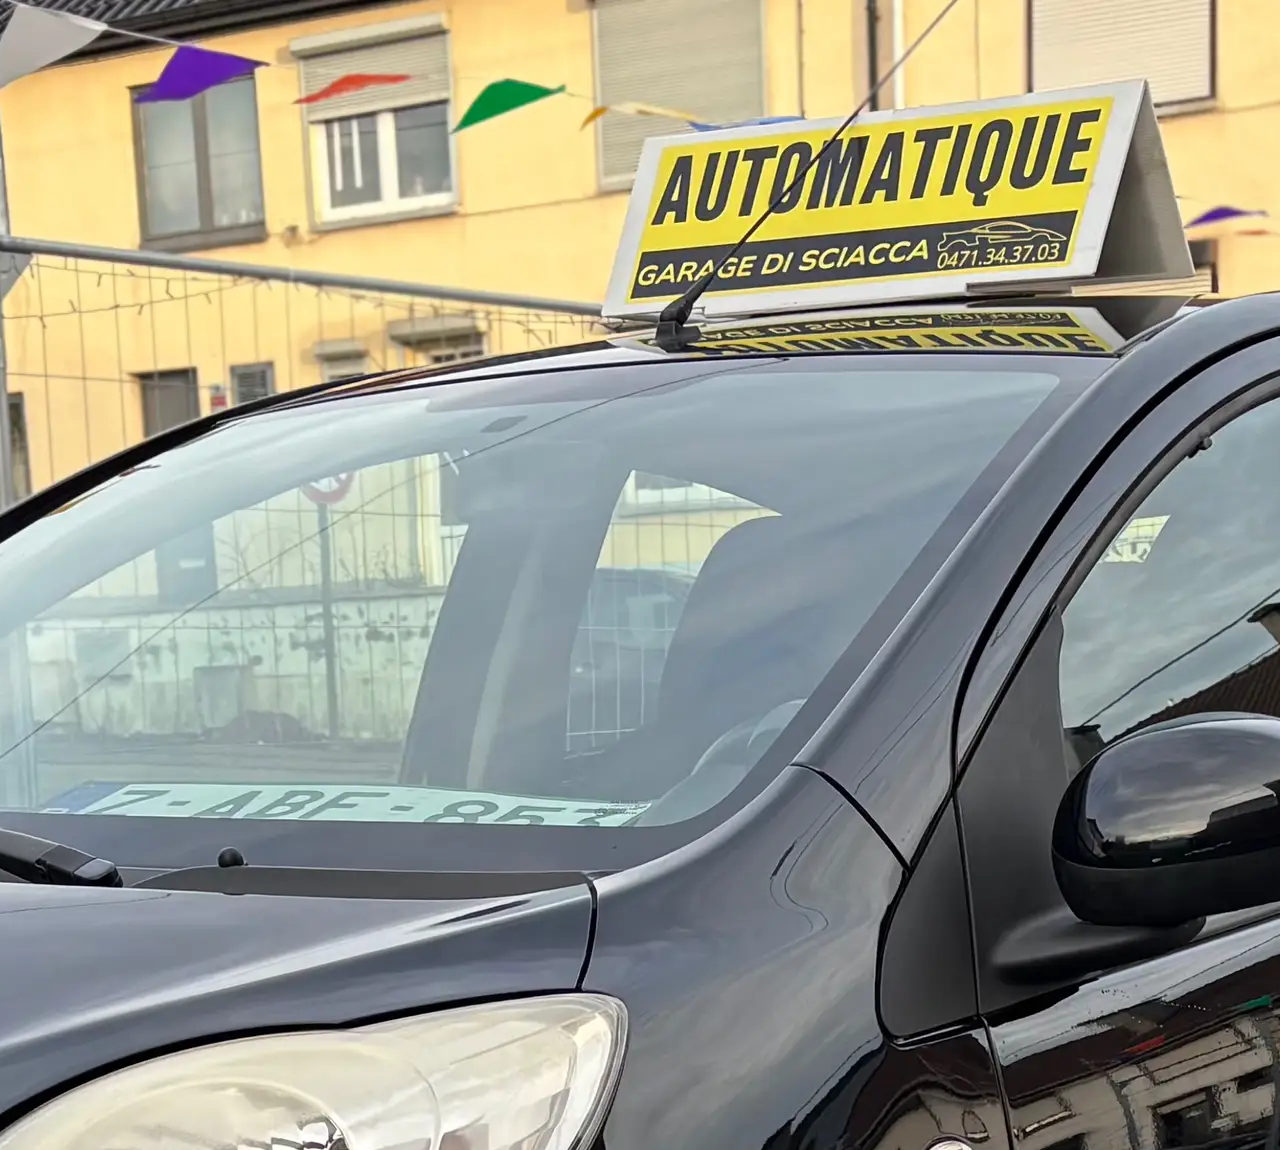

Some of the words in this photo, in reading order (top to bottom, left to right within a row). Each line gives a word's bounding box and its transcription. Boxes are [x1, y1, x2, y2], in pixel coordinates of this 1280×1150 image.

[651, 108, 1102, 225] AUTOMATIQUE
[639, 257, 753, 287] GARAGE
[759, 252, 792, 275] DI
[797, 240, 930, 272] SCIACCA
[937, 242, 1060, 271] 0471.34.37.03
